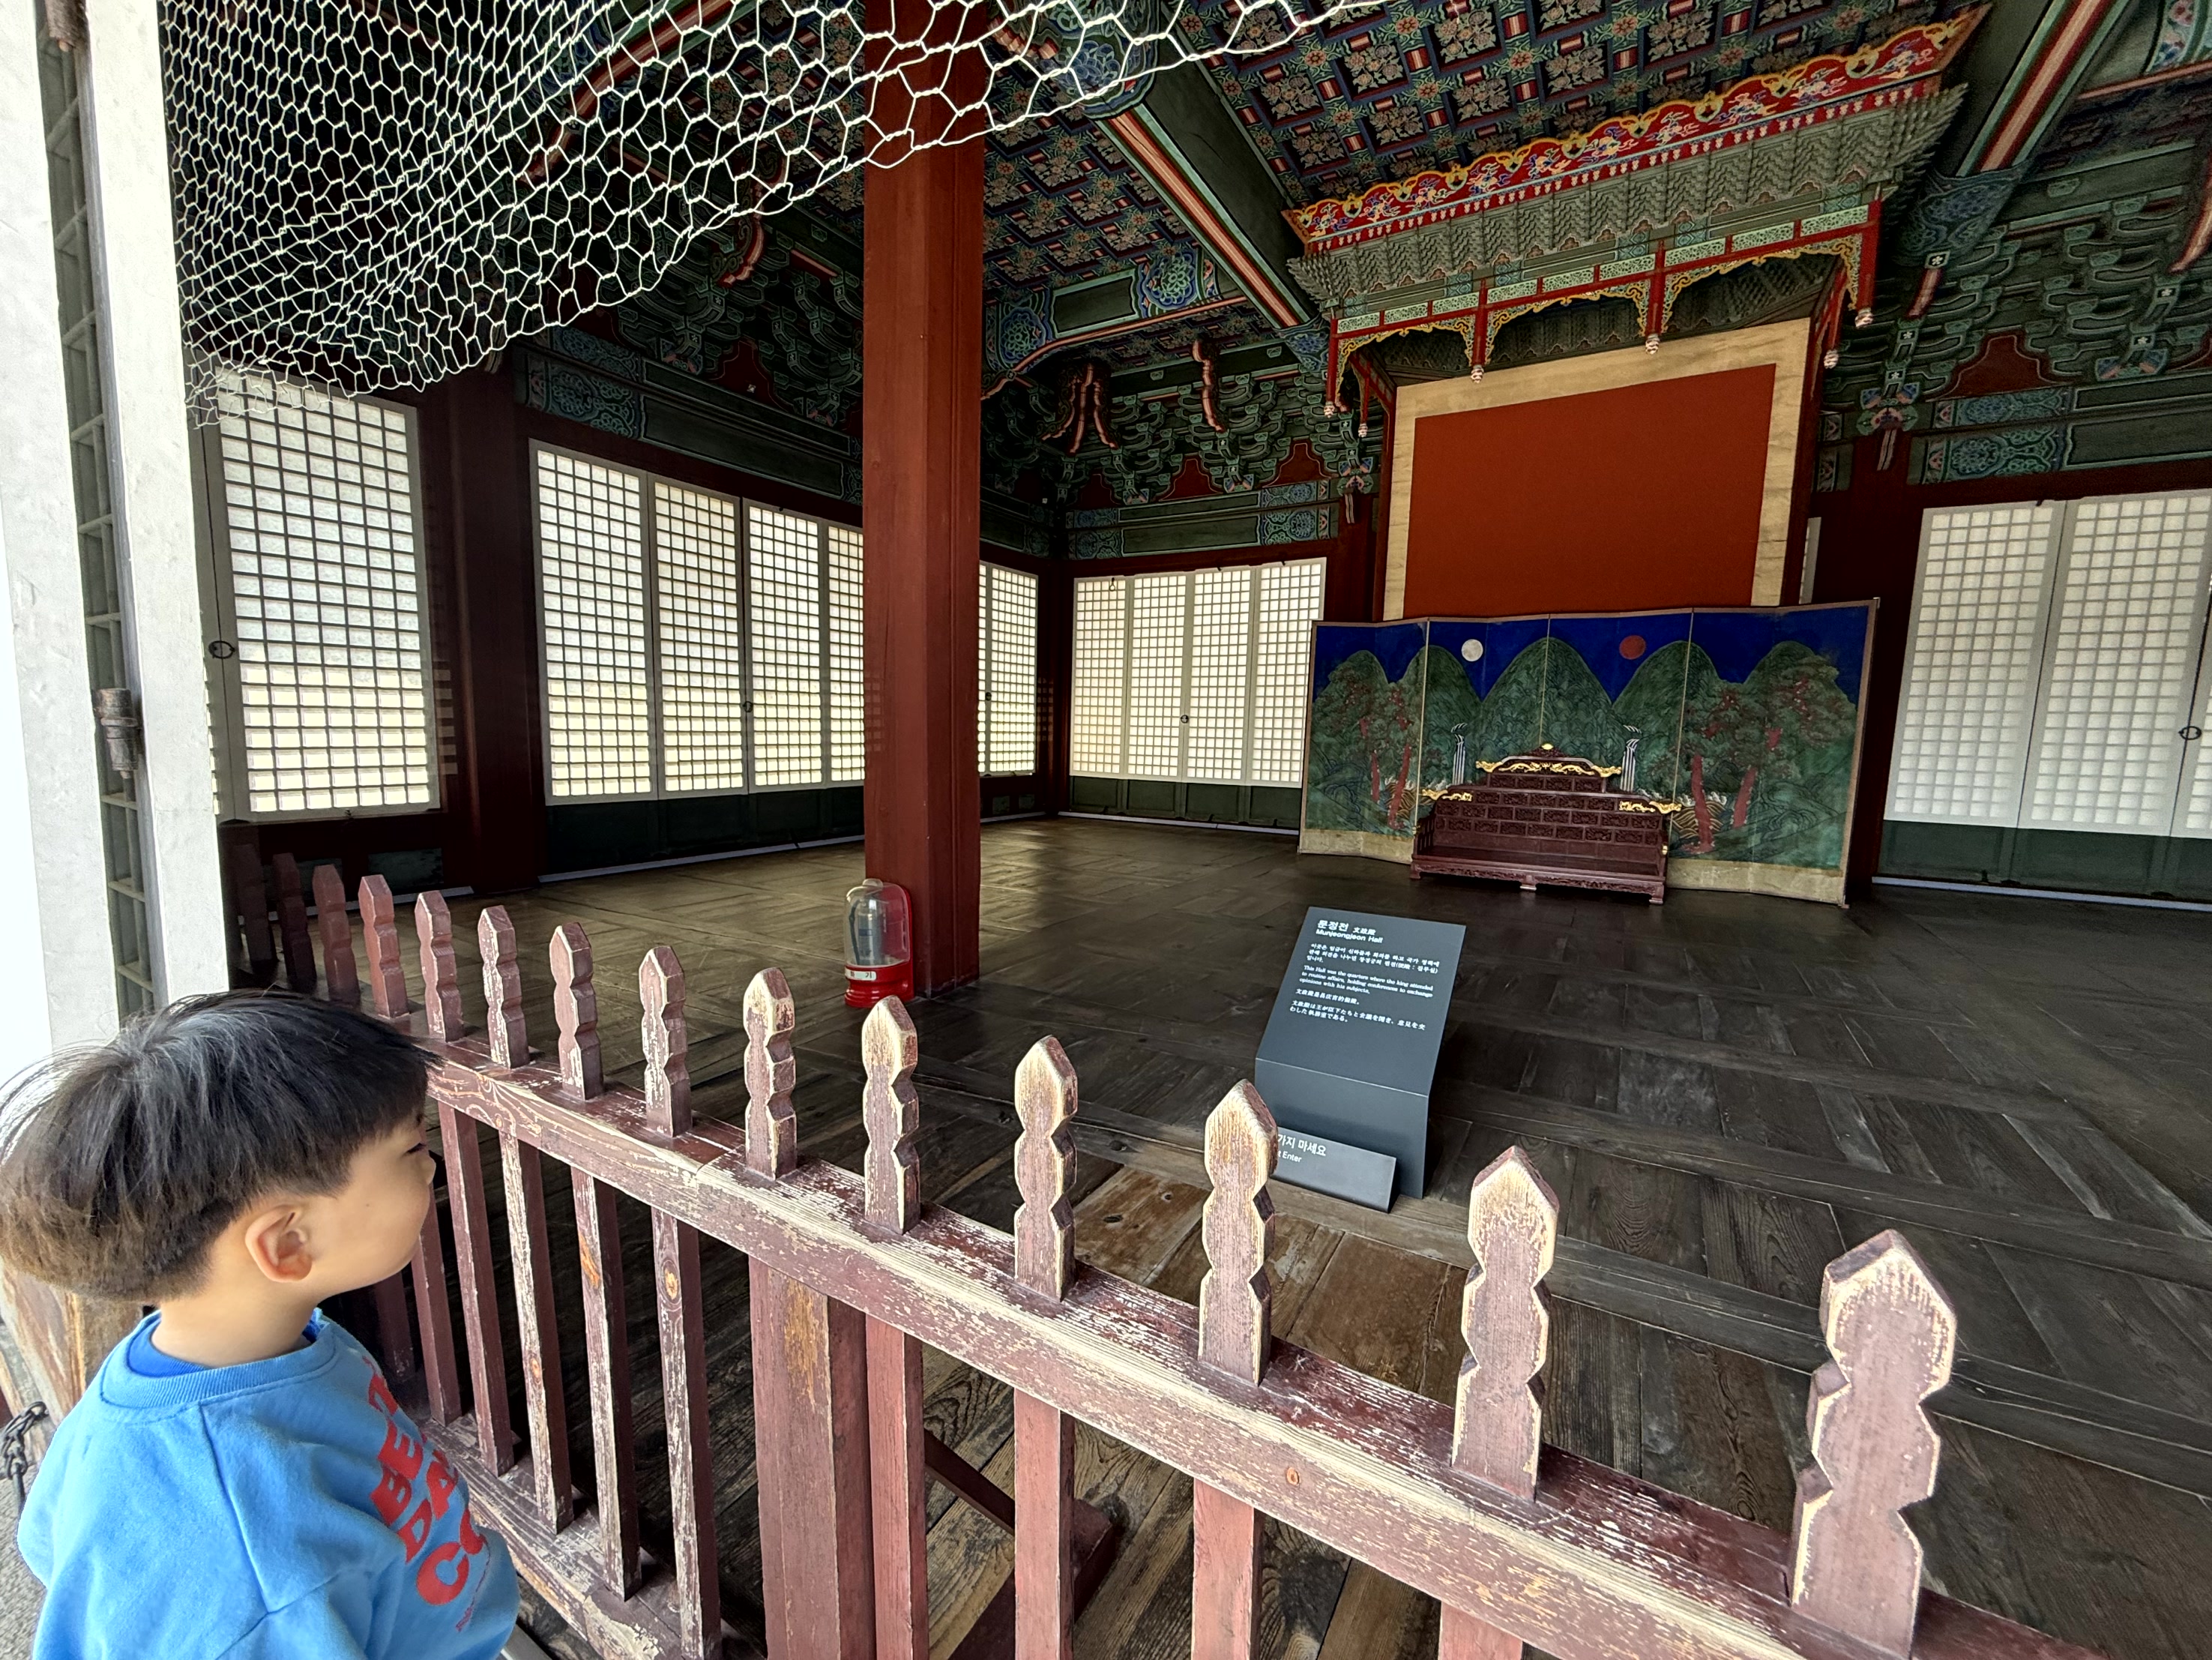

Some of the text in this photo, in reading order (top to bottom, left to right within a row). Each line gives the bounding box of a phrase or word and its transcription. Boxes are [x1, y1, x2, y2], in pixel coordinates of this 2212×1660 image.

[1316, 928, 1384, 943] Munjeongjeon Hall
[1352, 927, 1376, 935] 文政殿
[1346, 978, 1367, 987] holding
[1366, 982, 1399, 991] conferences
[1406, 989, 1433, 997] exchange
[1278, 1134, 1295, 1149] 가지
[1298, 1140, 1327, 1156] 마세요
[1283, 1152, 1302, 1163] Enter
